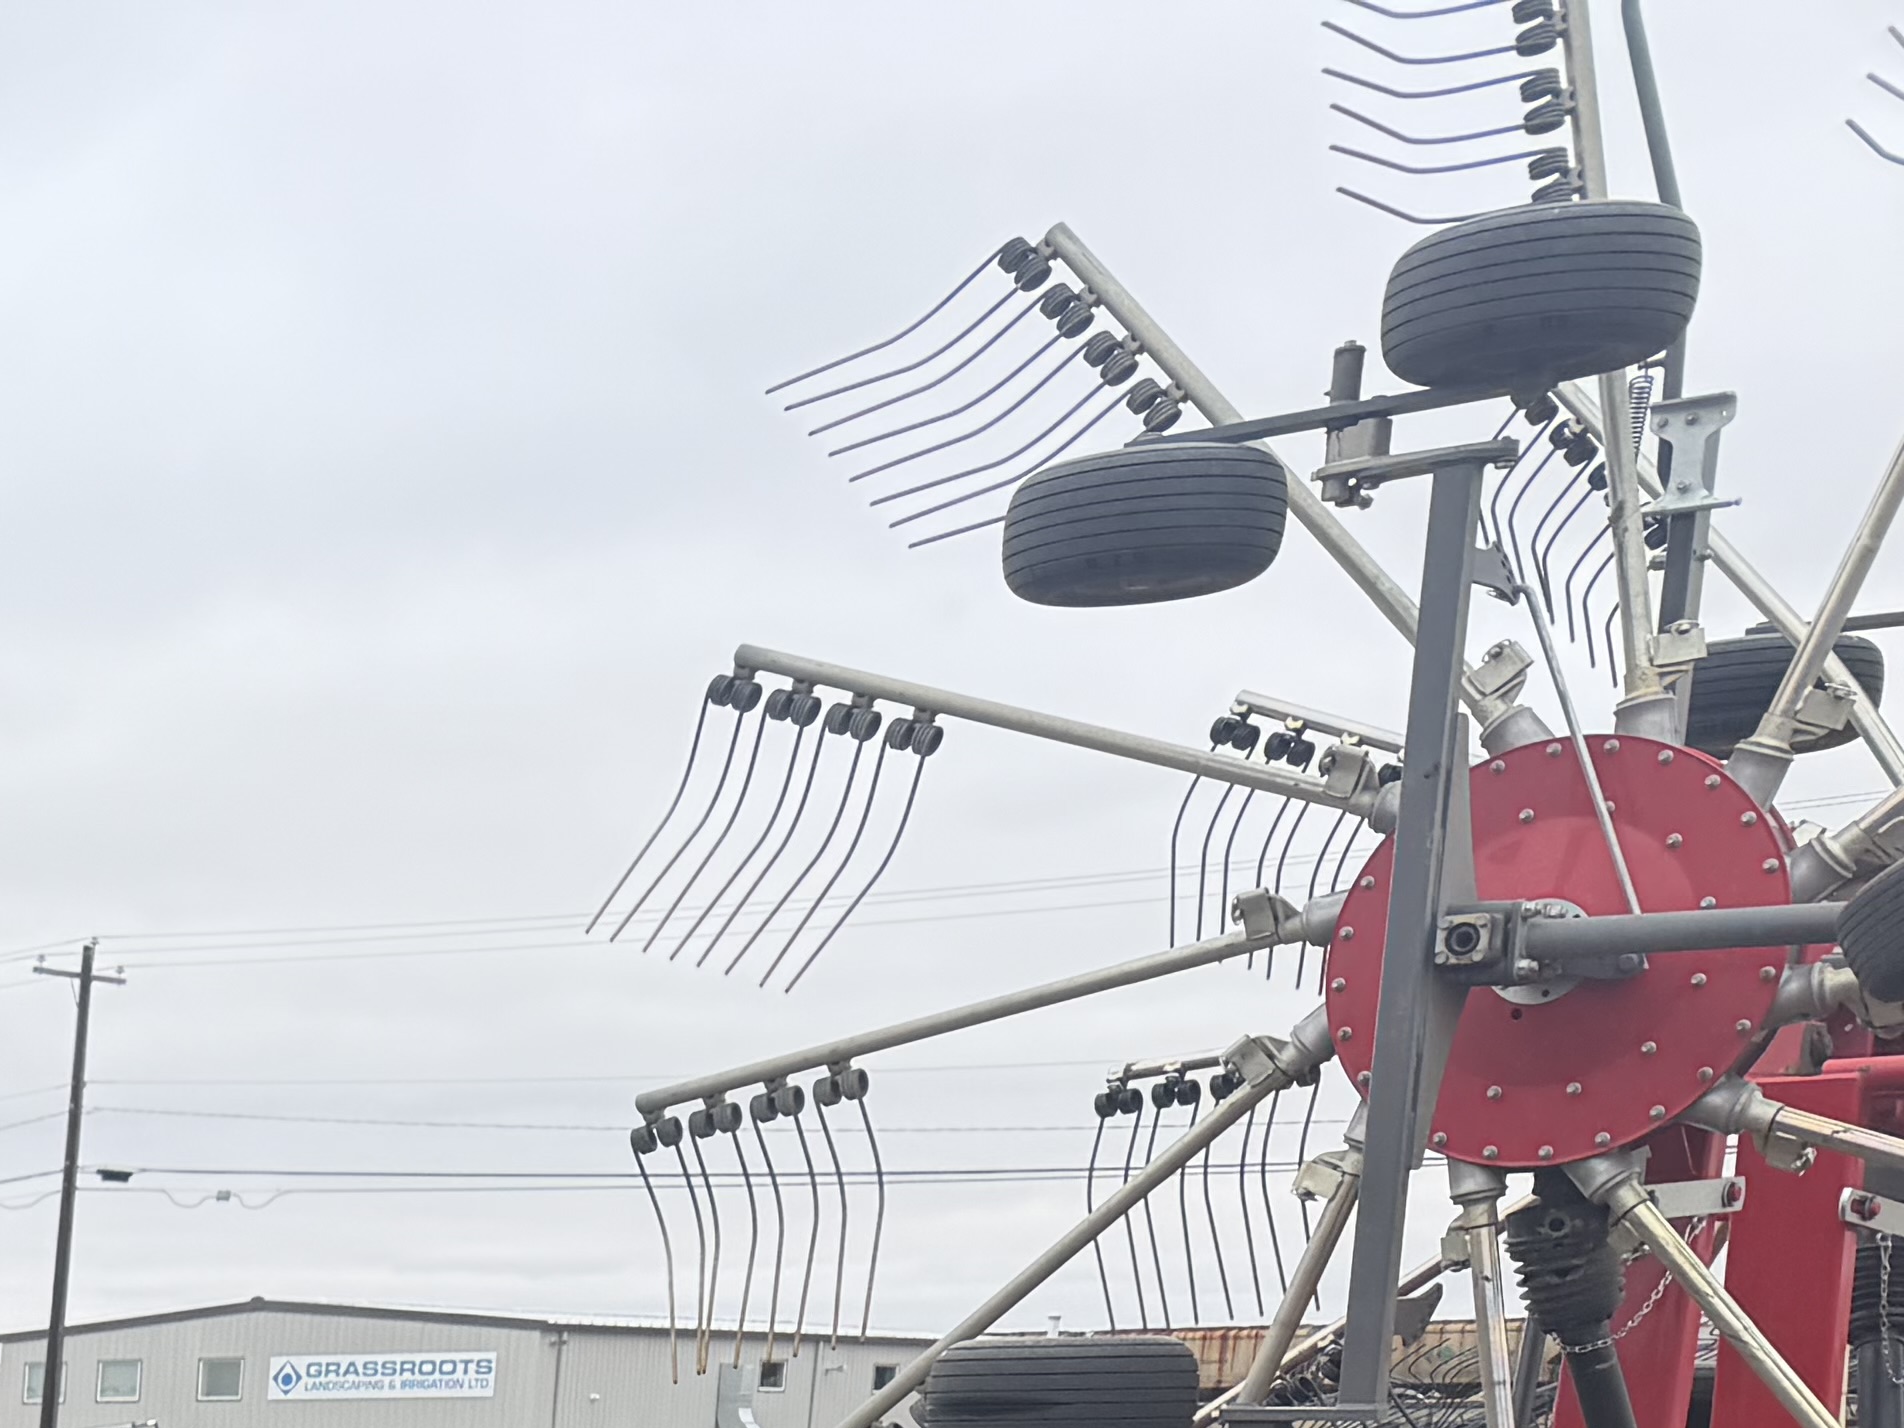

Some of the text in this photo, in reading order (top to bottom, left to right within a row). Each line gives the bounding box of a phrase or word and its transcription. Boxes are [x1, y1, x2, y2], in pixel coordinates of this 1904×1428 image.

[305, 1358, 494, 1378] GRASSROOTS
[304, 1379, 384, 1391] LANDSCAPING
[399, 1378, 465, 1390] IRRIGATION
